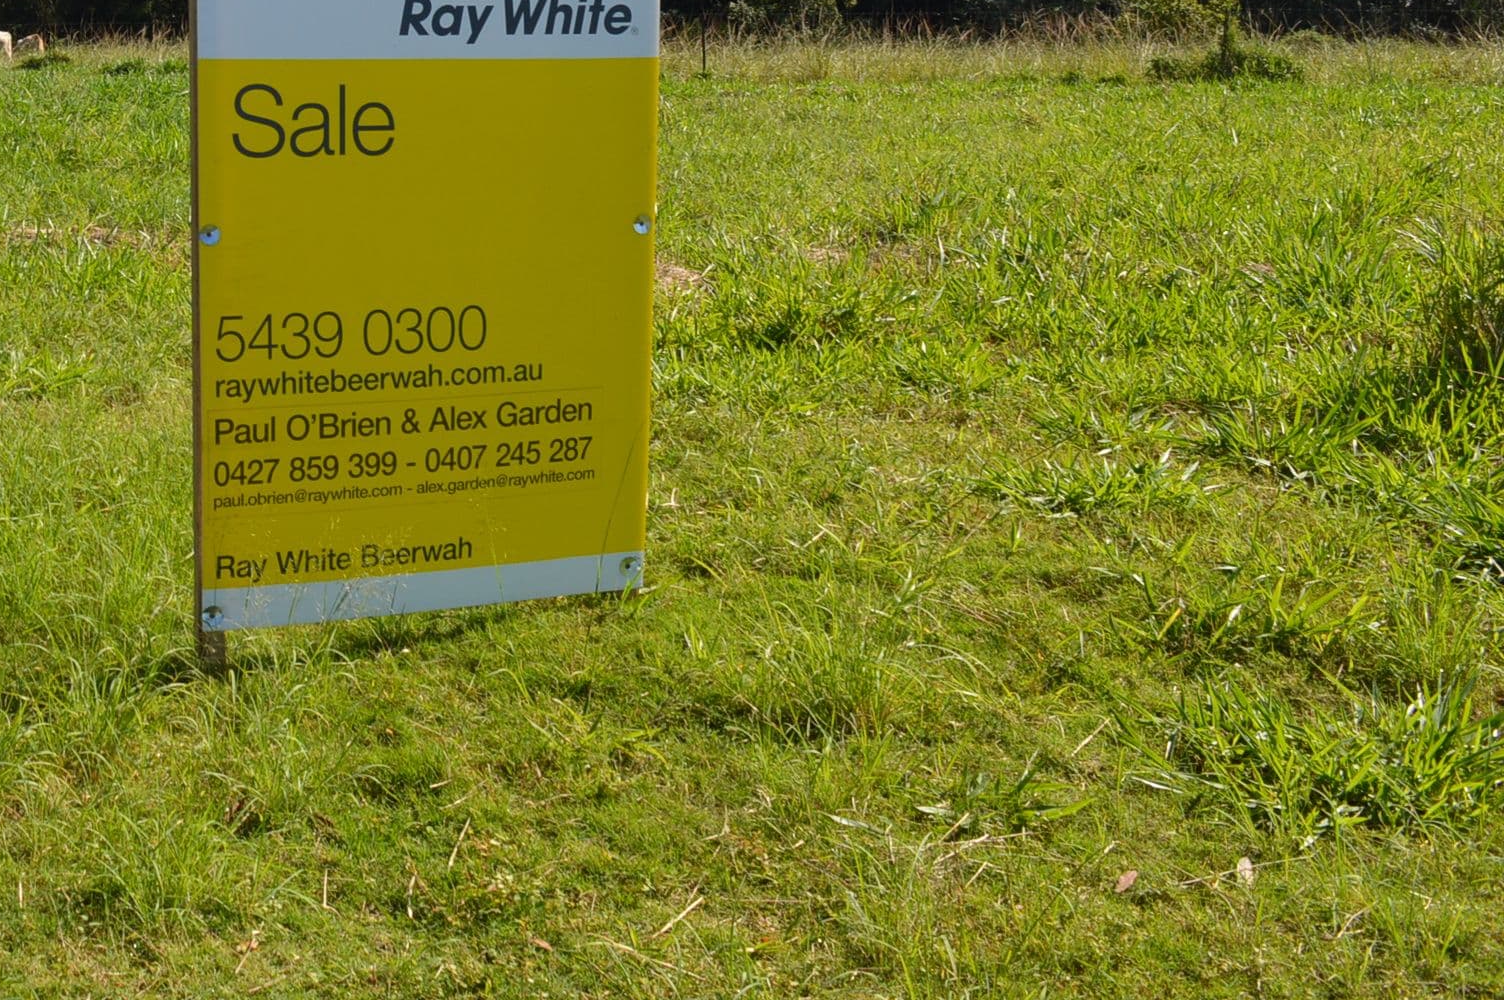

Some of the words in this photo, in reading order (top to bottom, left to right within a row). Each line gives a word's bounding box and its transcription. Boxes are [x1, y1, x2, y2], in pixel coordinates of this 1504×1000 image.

[231, 83, 396, 159] Sale
[215, 311, 344, 363] 5439
[363, 305, 488, 356] 0300
[215, 362, 544, 404] raywhitebeerwah.com.au
[214, 416, 277, 445] Paul
[400, 408, 421, 435] &
[429, 405, 489, 433] Alex
[496, 398, 594, 428] Garden
[214, 458, 280, 488] 0427
[289, 454, 340, 483] 859
[348, 450, 398, 478] 399
[424, 444, 488, 474] 0407
[496, 440, 542, 468] 245
[549, 436, 594, 464] 287
[213, 482, 404, 512] paul.obrien@raywhite.com
[416, 467, 596, 495] alex.garden@raywhite.com
[215, 555, 268, 583] Ray
[276, 547, 352, 576] White
[361, 537, 474, 569] Beerwah
